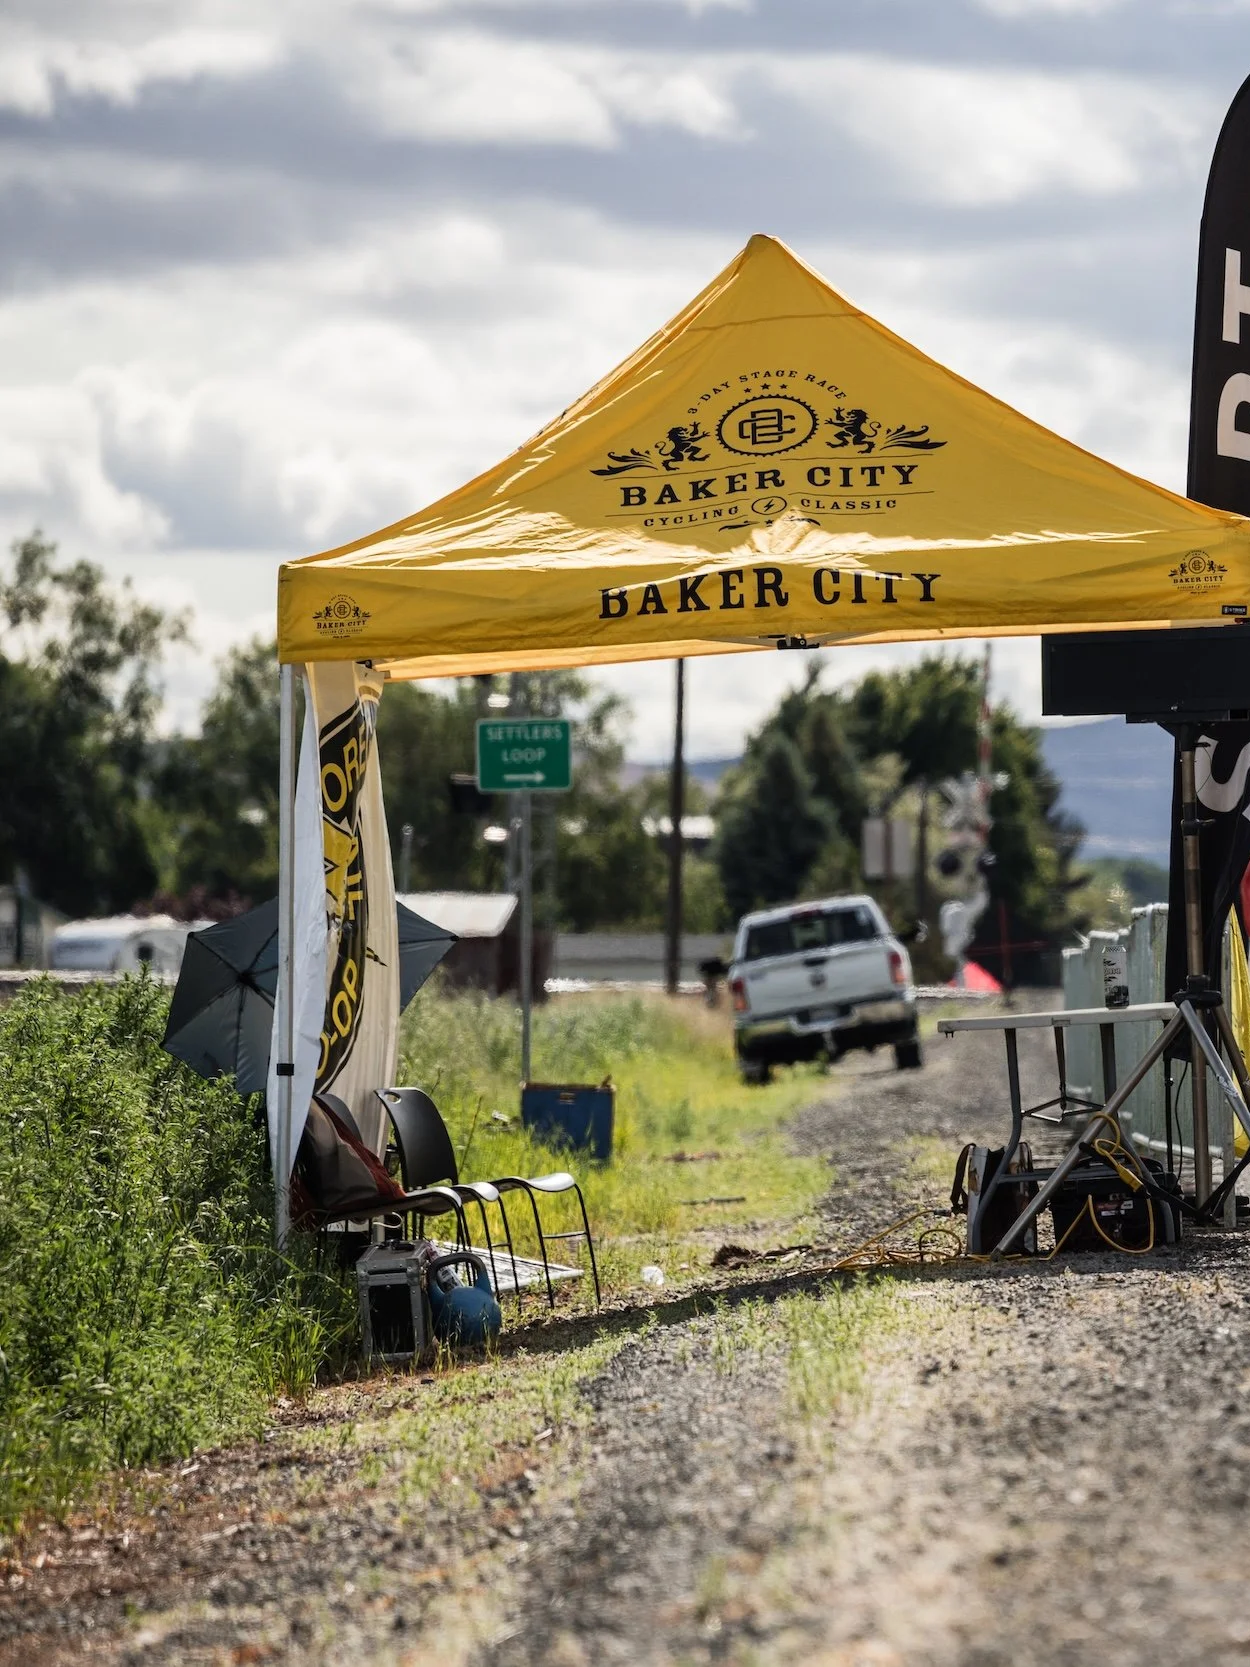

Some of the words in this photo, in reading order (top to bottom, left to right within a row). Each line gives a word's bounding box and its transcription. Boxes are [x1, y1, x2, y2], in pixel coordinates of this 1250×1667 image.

[738, 370, 798, 384] STAGE
[805, 373, 848, 400] RACE
[620, 469, 786, 507] BAKER
[806, 464, 919, 488] CITY
[643, 505, 739, 528] CYCLING
[800, 498, 898, 511] CLASSIC
[598, 567, 789, 619] BAKER
[813, 567, 941, 606] CITY
[316, 622, 345, 630] BAKER
[485, 724, 563, 741] SETTLERS
[501, 748, 546, 764] LOOP
